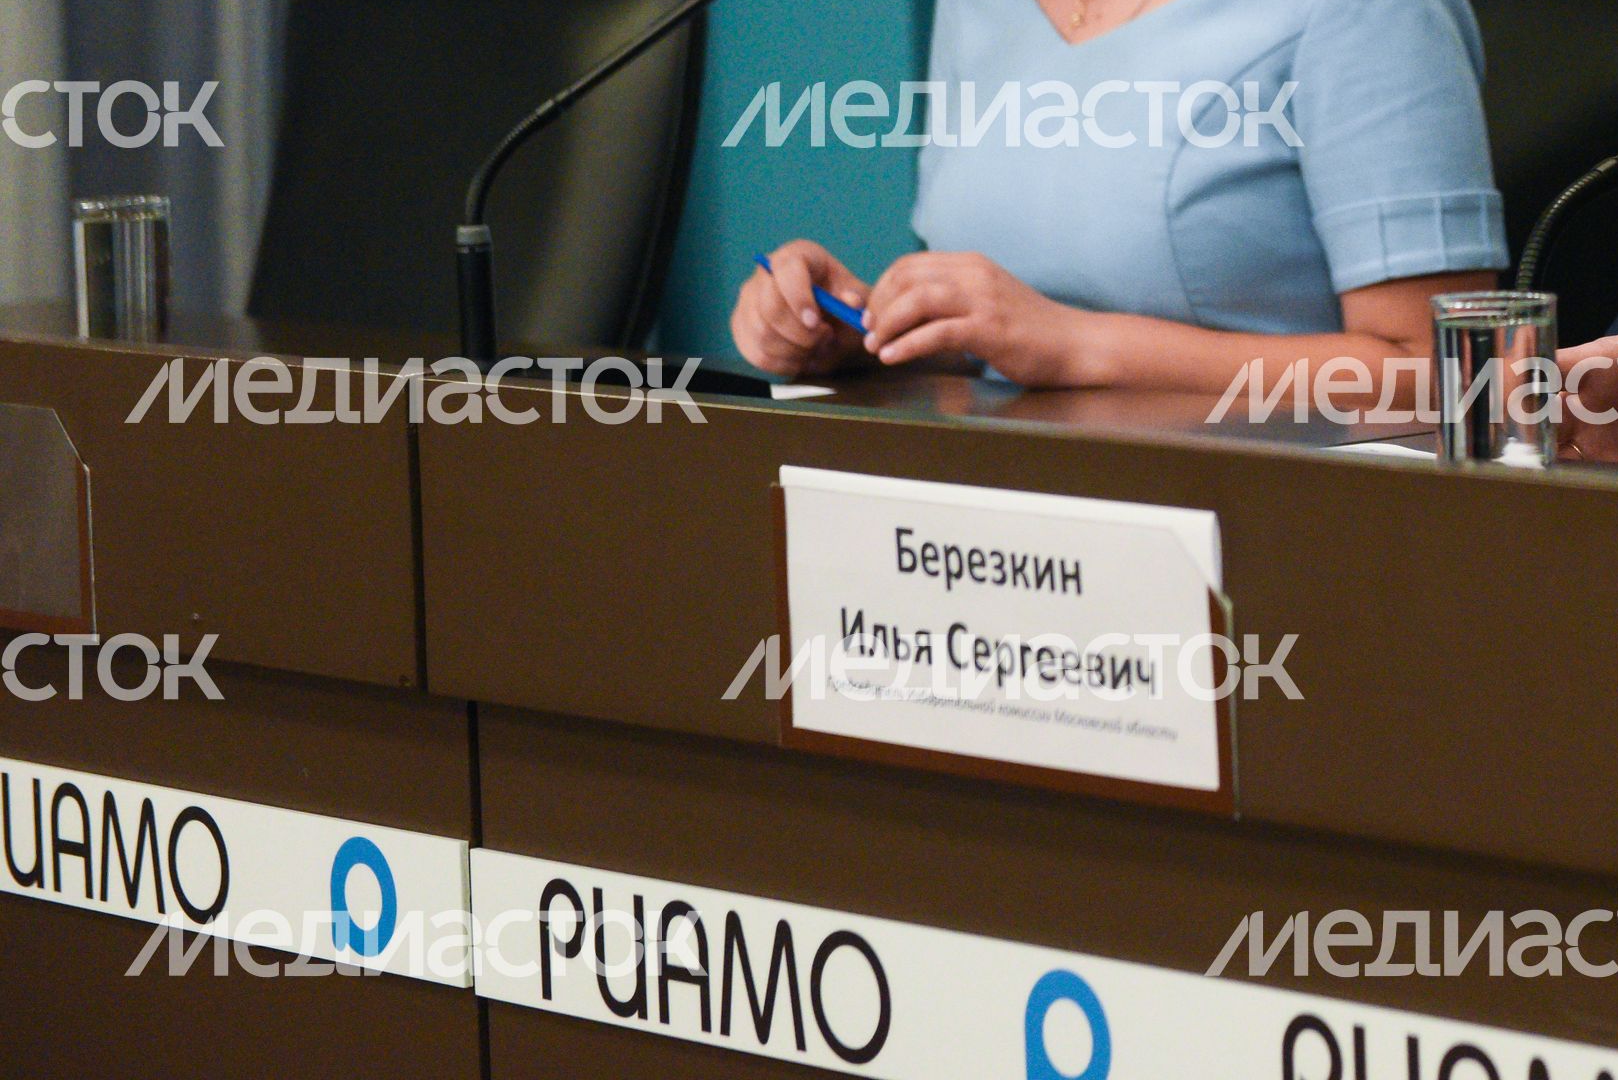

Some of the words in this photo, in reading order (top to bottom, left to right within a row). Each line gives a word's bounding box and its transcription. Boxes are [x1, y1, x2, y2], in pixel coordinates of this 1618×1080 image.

[894, 527, 1083, 596] Березкин
[841, 606, 933, 667] Илья
[946, 622, 1157, 697] Сергеевич
